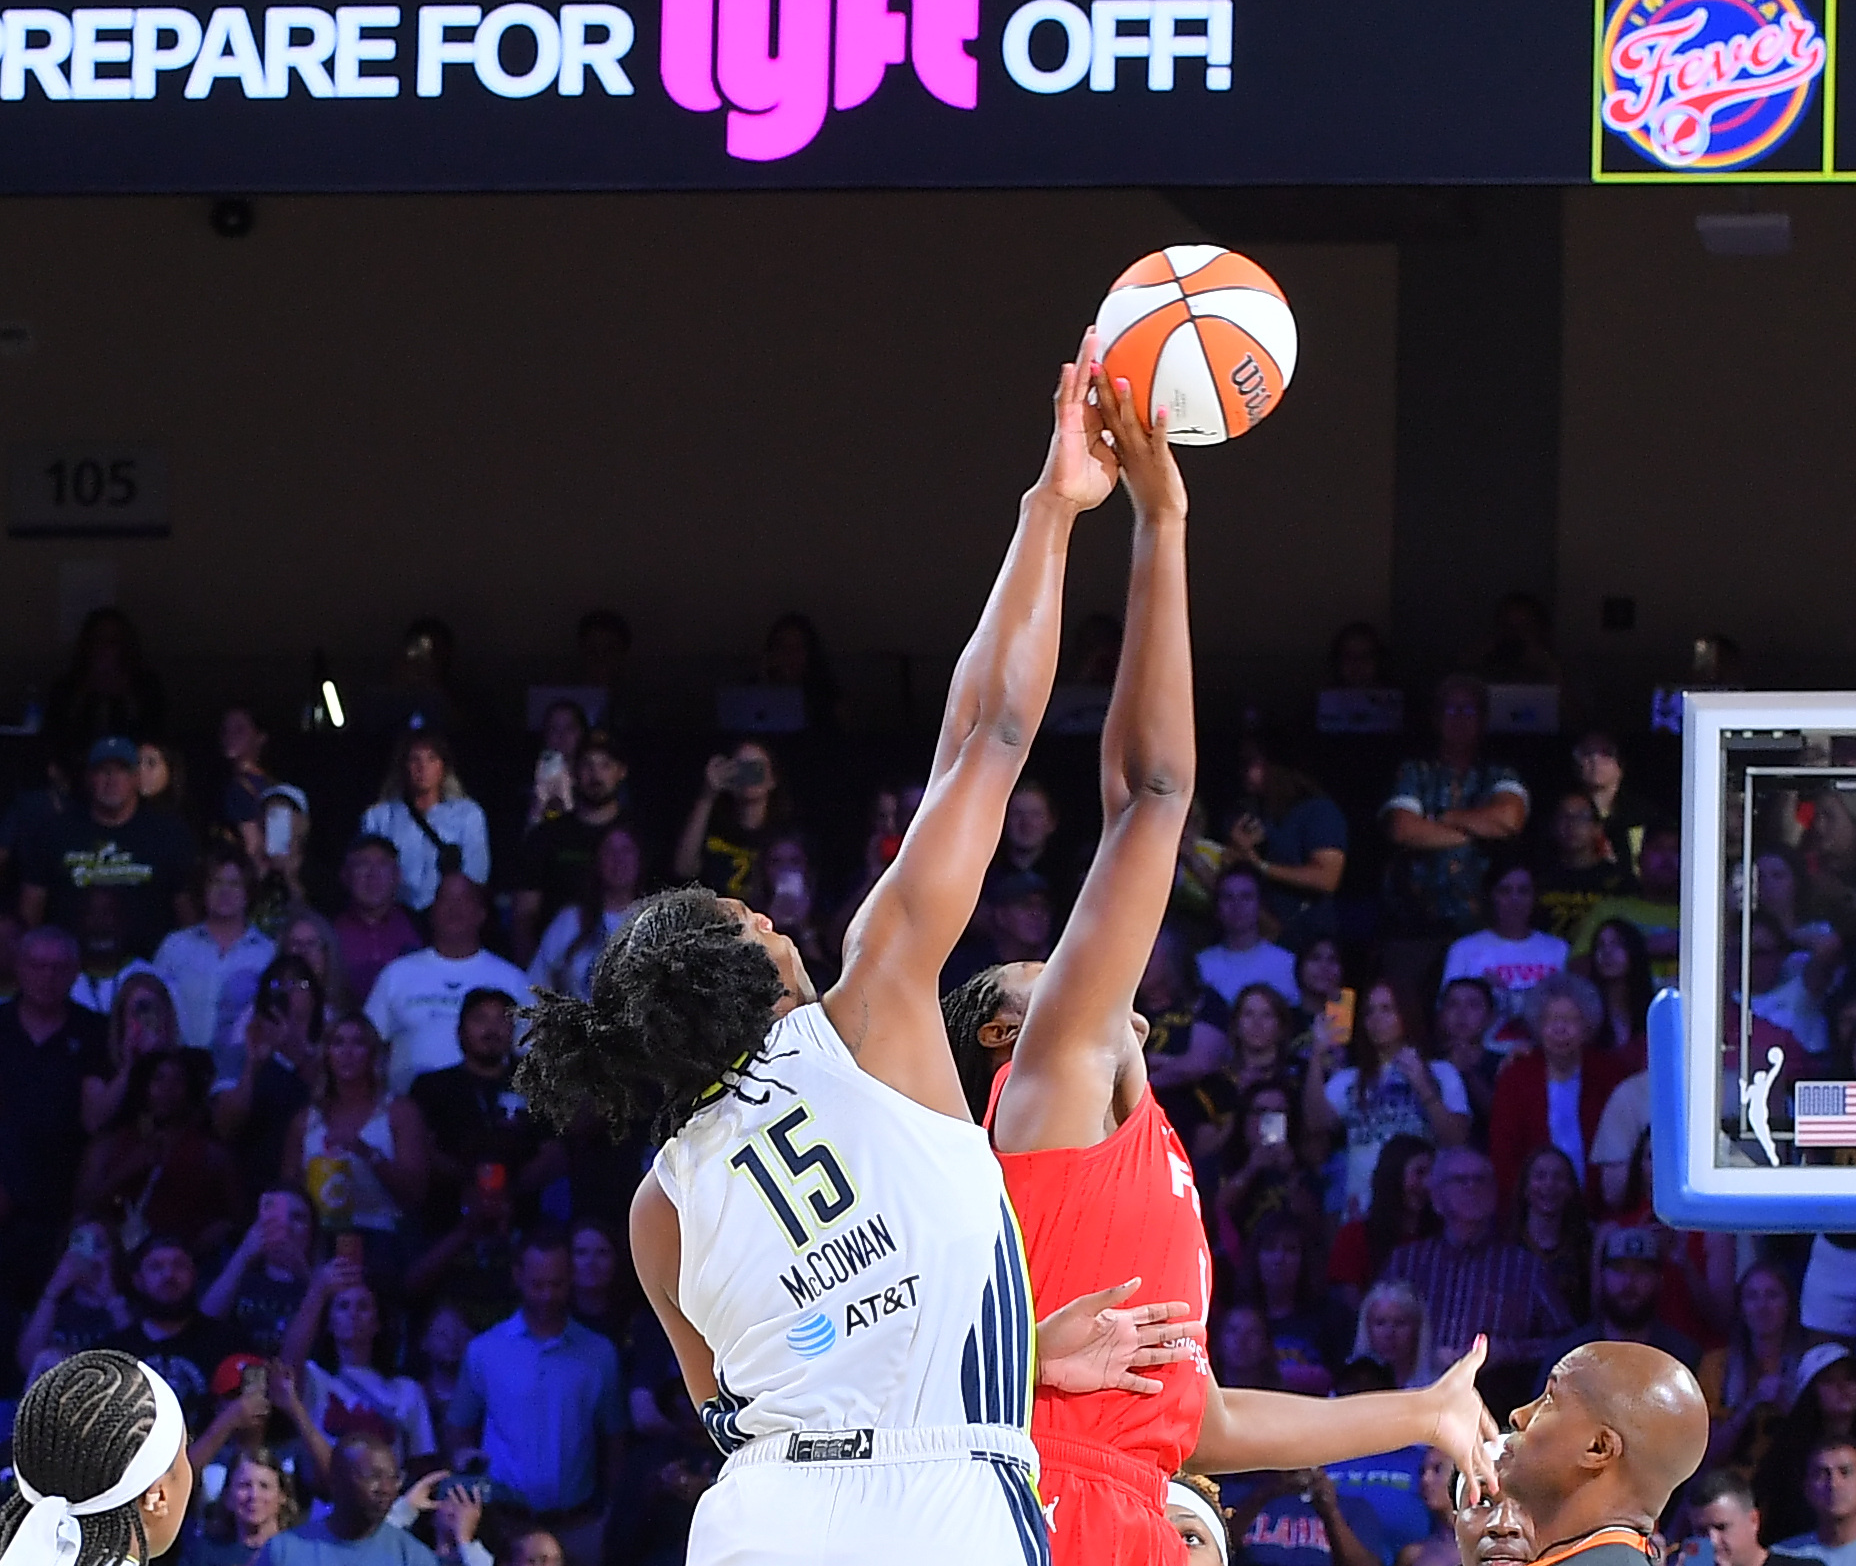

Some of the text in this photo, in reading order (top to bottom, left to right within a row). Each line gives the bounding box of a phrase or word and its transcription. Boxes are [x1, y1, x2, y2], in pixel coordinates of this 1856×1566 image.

[416, 5, 635, 99] FOR
[659, 0, 980, 162] lyft
[1001, 0, 1234, 93] OFF!
[1605, 8, 1825, 122] Fever
[1231, 352, 1273, 428] Wil
[46, 459, 137, 508] 105
[722, 1100, 861, 1258] 15
[844, 1274, 921, 1338] AT&T
